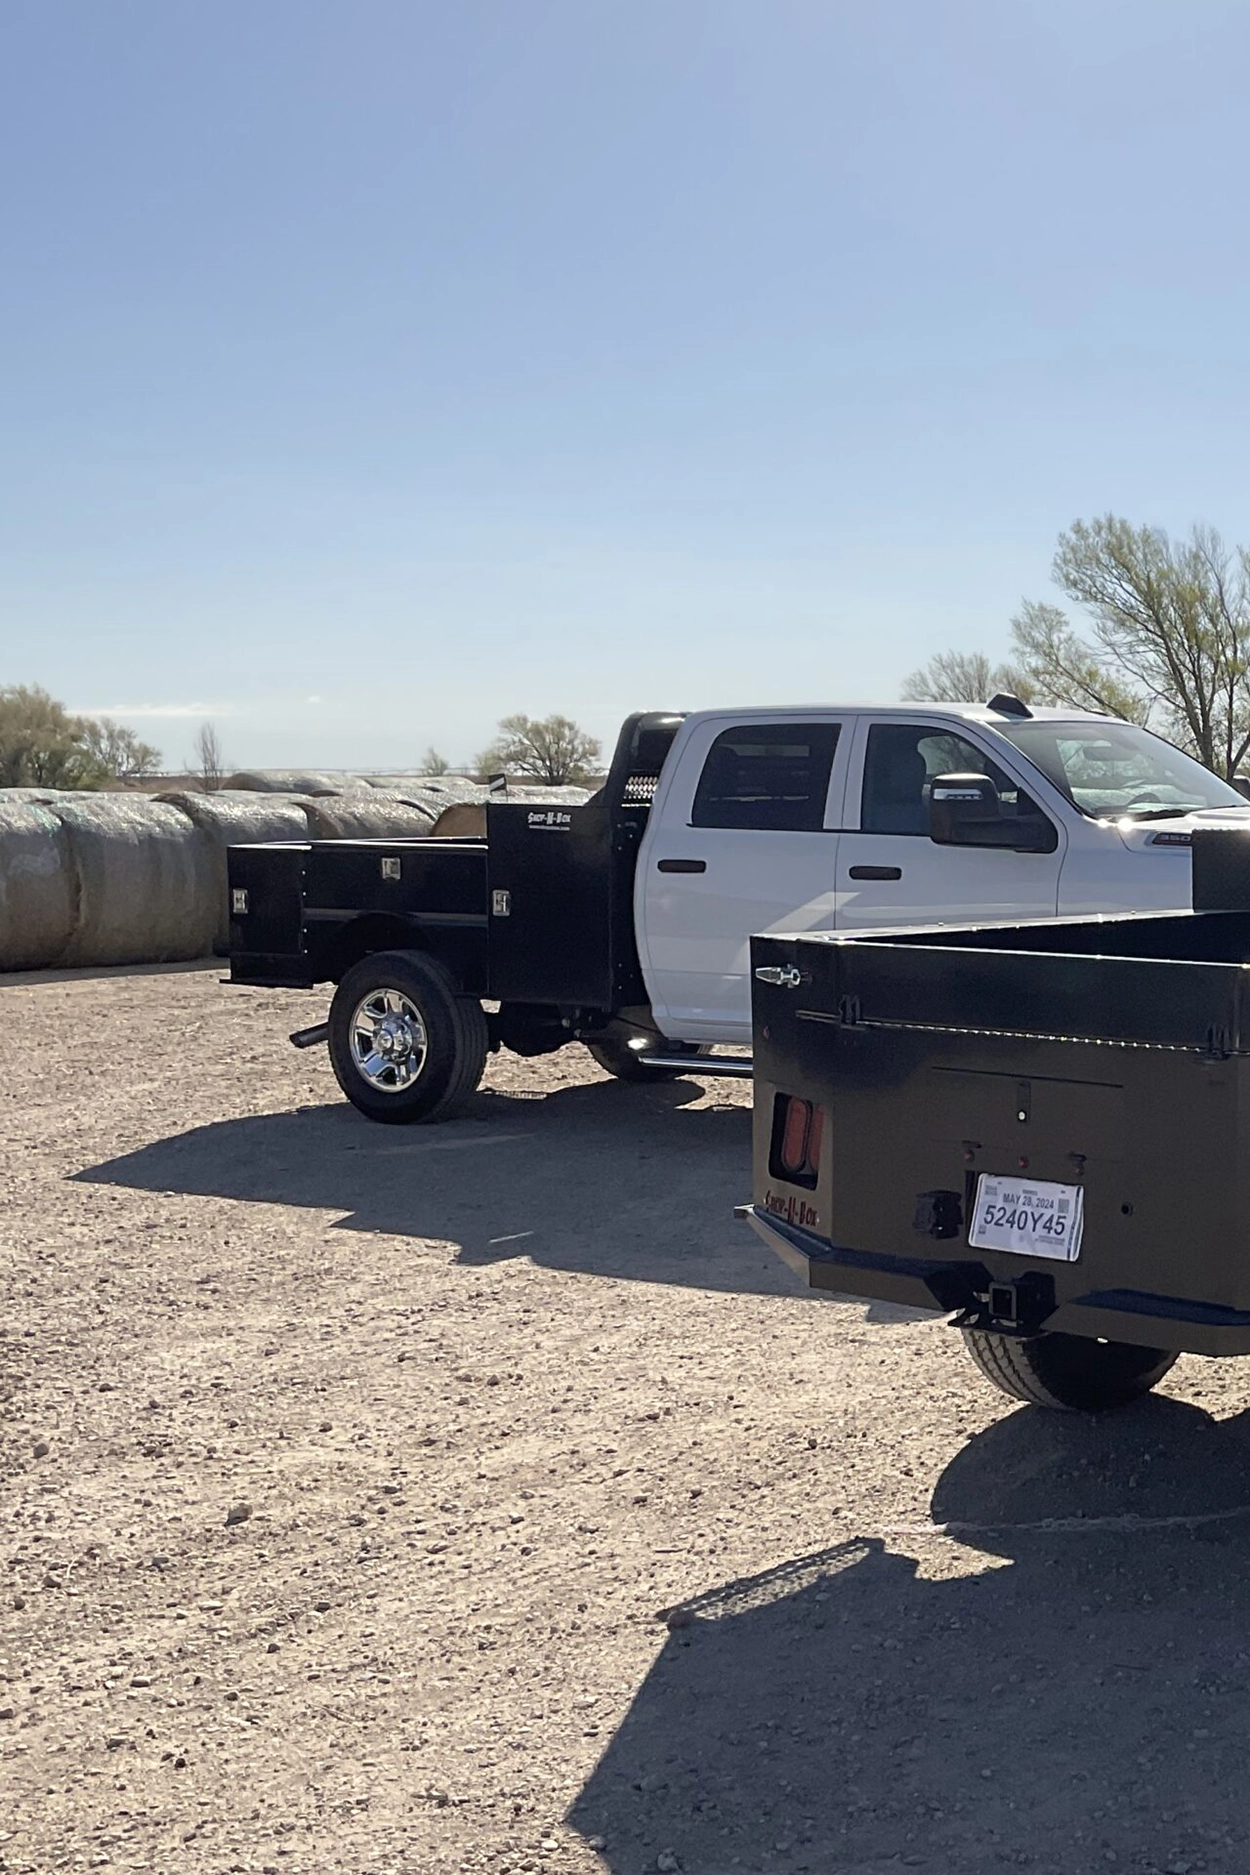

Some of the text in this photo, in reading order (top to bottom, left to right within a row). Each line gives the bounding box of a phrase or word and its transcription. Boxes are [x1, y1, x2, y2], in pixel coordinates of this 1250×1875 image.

[1003, 1193, 1021, 1205] MAY
[1036, 1198, 1054, 1210] 2024
[984, 1204, 1067, 1236] 5240Y45
